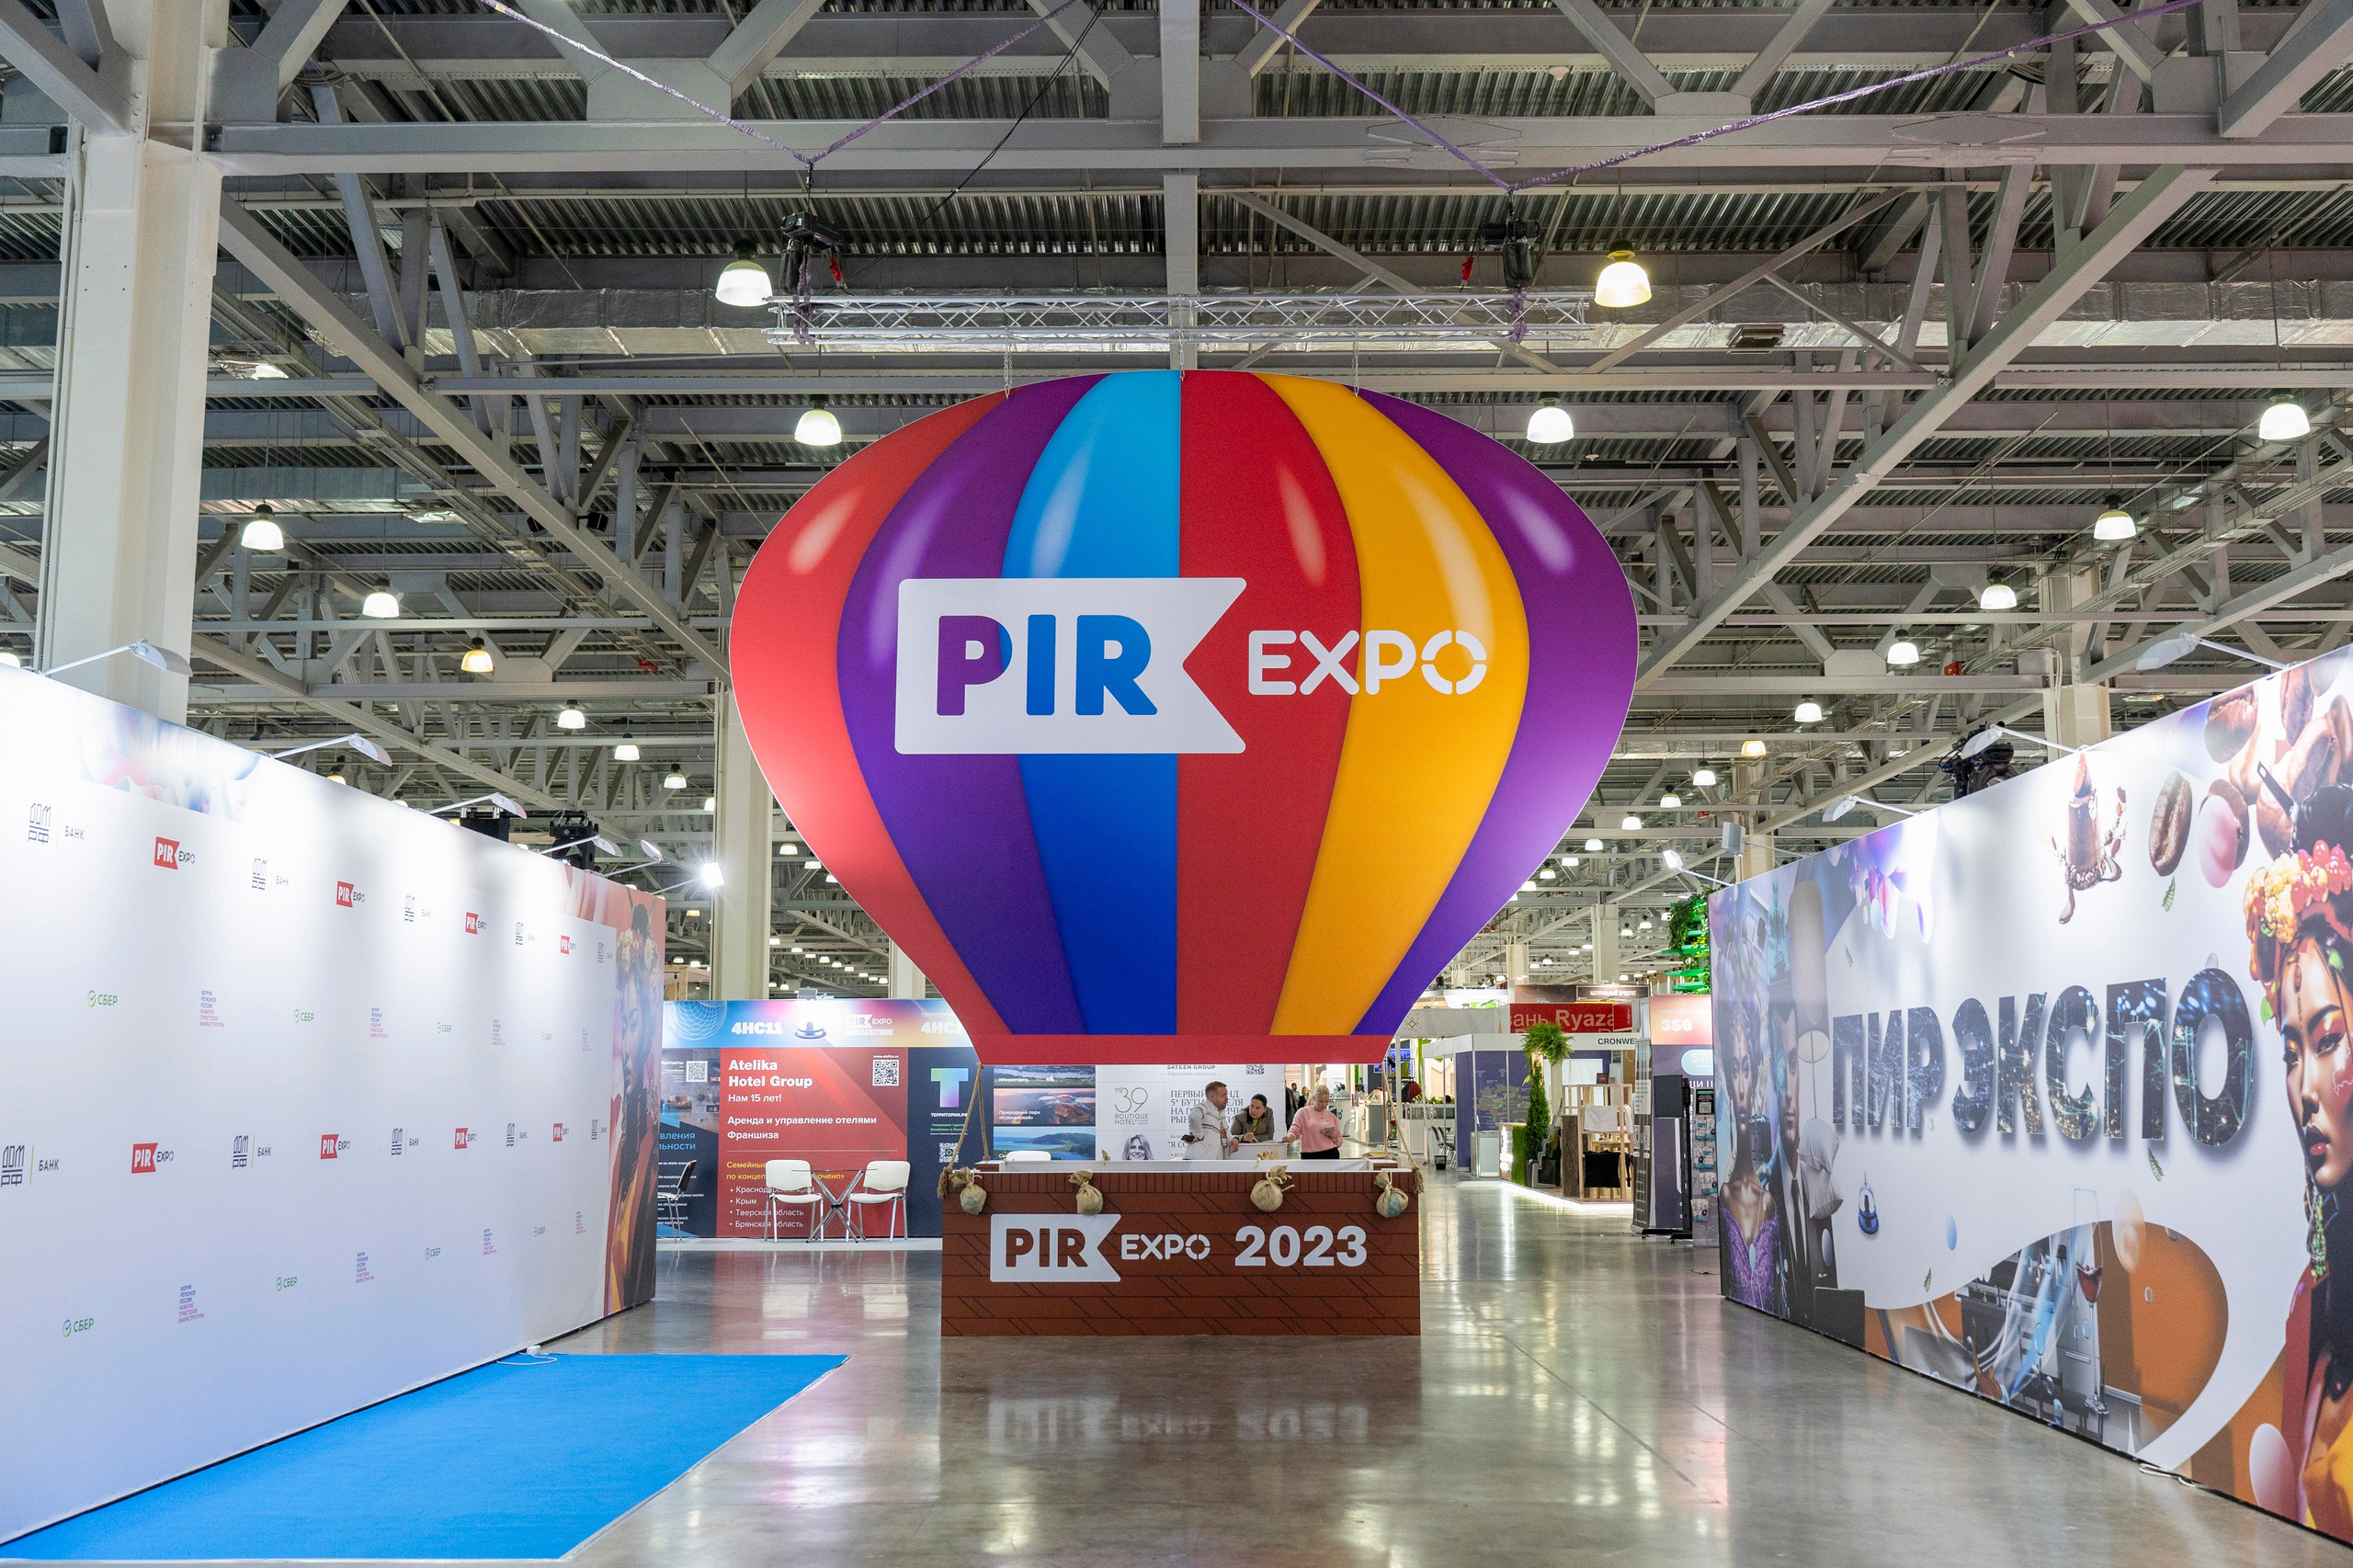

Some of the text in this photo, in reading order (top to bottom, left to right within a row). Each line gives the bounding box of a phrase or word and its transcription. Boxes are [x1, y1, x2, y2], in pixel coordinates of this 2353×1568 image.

[936, 614, 1487, 716] PIR EXPO
[65, 826, 85, 840] БАНК
[157, 843, 196, 864] PIR EXPO
[338, 885, 365, 903] PIR EXPO
[98, 994, 118, 1006] СБЕР
[301, 1012, 314, 1022] СБЕР
[848, 1017, 866, 1027] PIR
[1510, 1012, 1548, 1027] ань
[1832, 968, 2256, 1147] ПИР ЭКСПО
[728, 1060, 778, 1071] Atelika
[728, 1075, 813, 1089] Hotel Group
[728, 1094, 782, 1102] Нам 15 лет!
[1114, 1087, 1149, 1113] 39
[1170, 1089, 1206, 1097] ПЕРВЫЙ
[727, 1117, 764, 1126] Аренда
[775, 1118, 833, 1126] управление
[456, 1131, 466, 1145] PIR
[727, 1131, 779, 1141] Франшиза
[257, 1147, 271, 1156] БАНК
[323, 1140, 350, 1154] PIR EXPO
[39, 1159, 60, 1171] БАНК
[134, 1151, 174, 1167] PIR EXPO
[1006, 1225, 1367, 1267] PIR EXPO 2023
[283, 1277, 297, 1288] СБЕР
[74, 1318, 94, 1332] СБЕР
